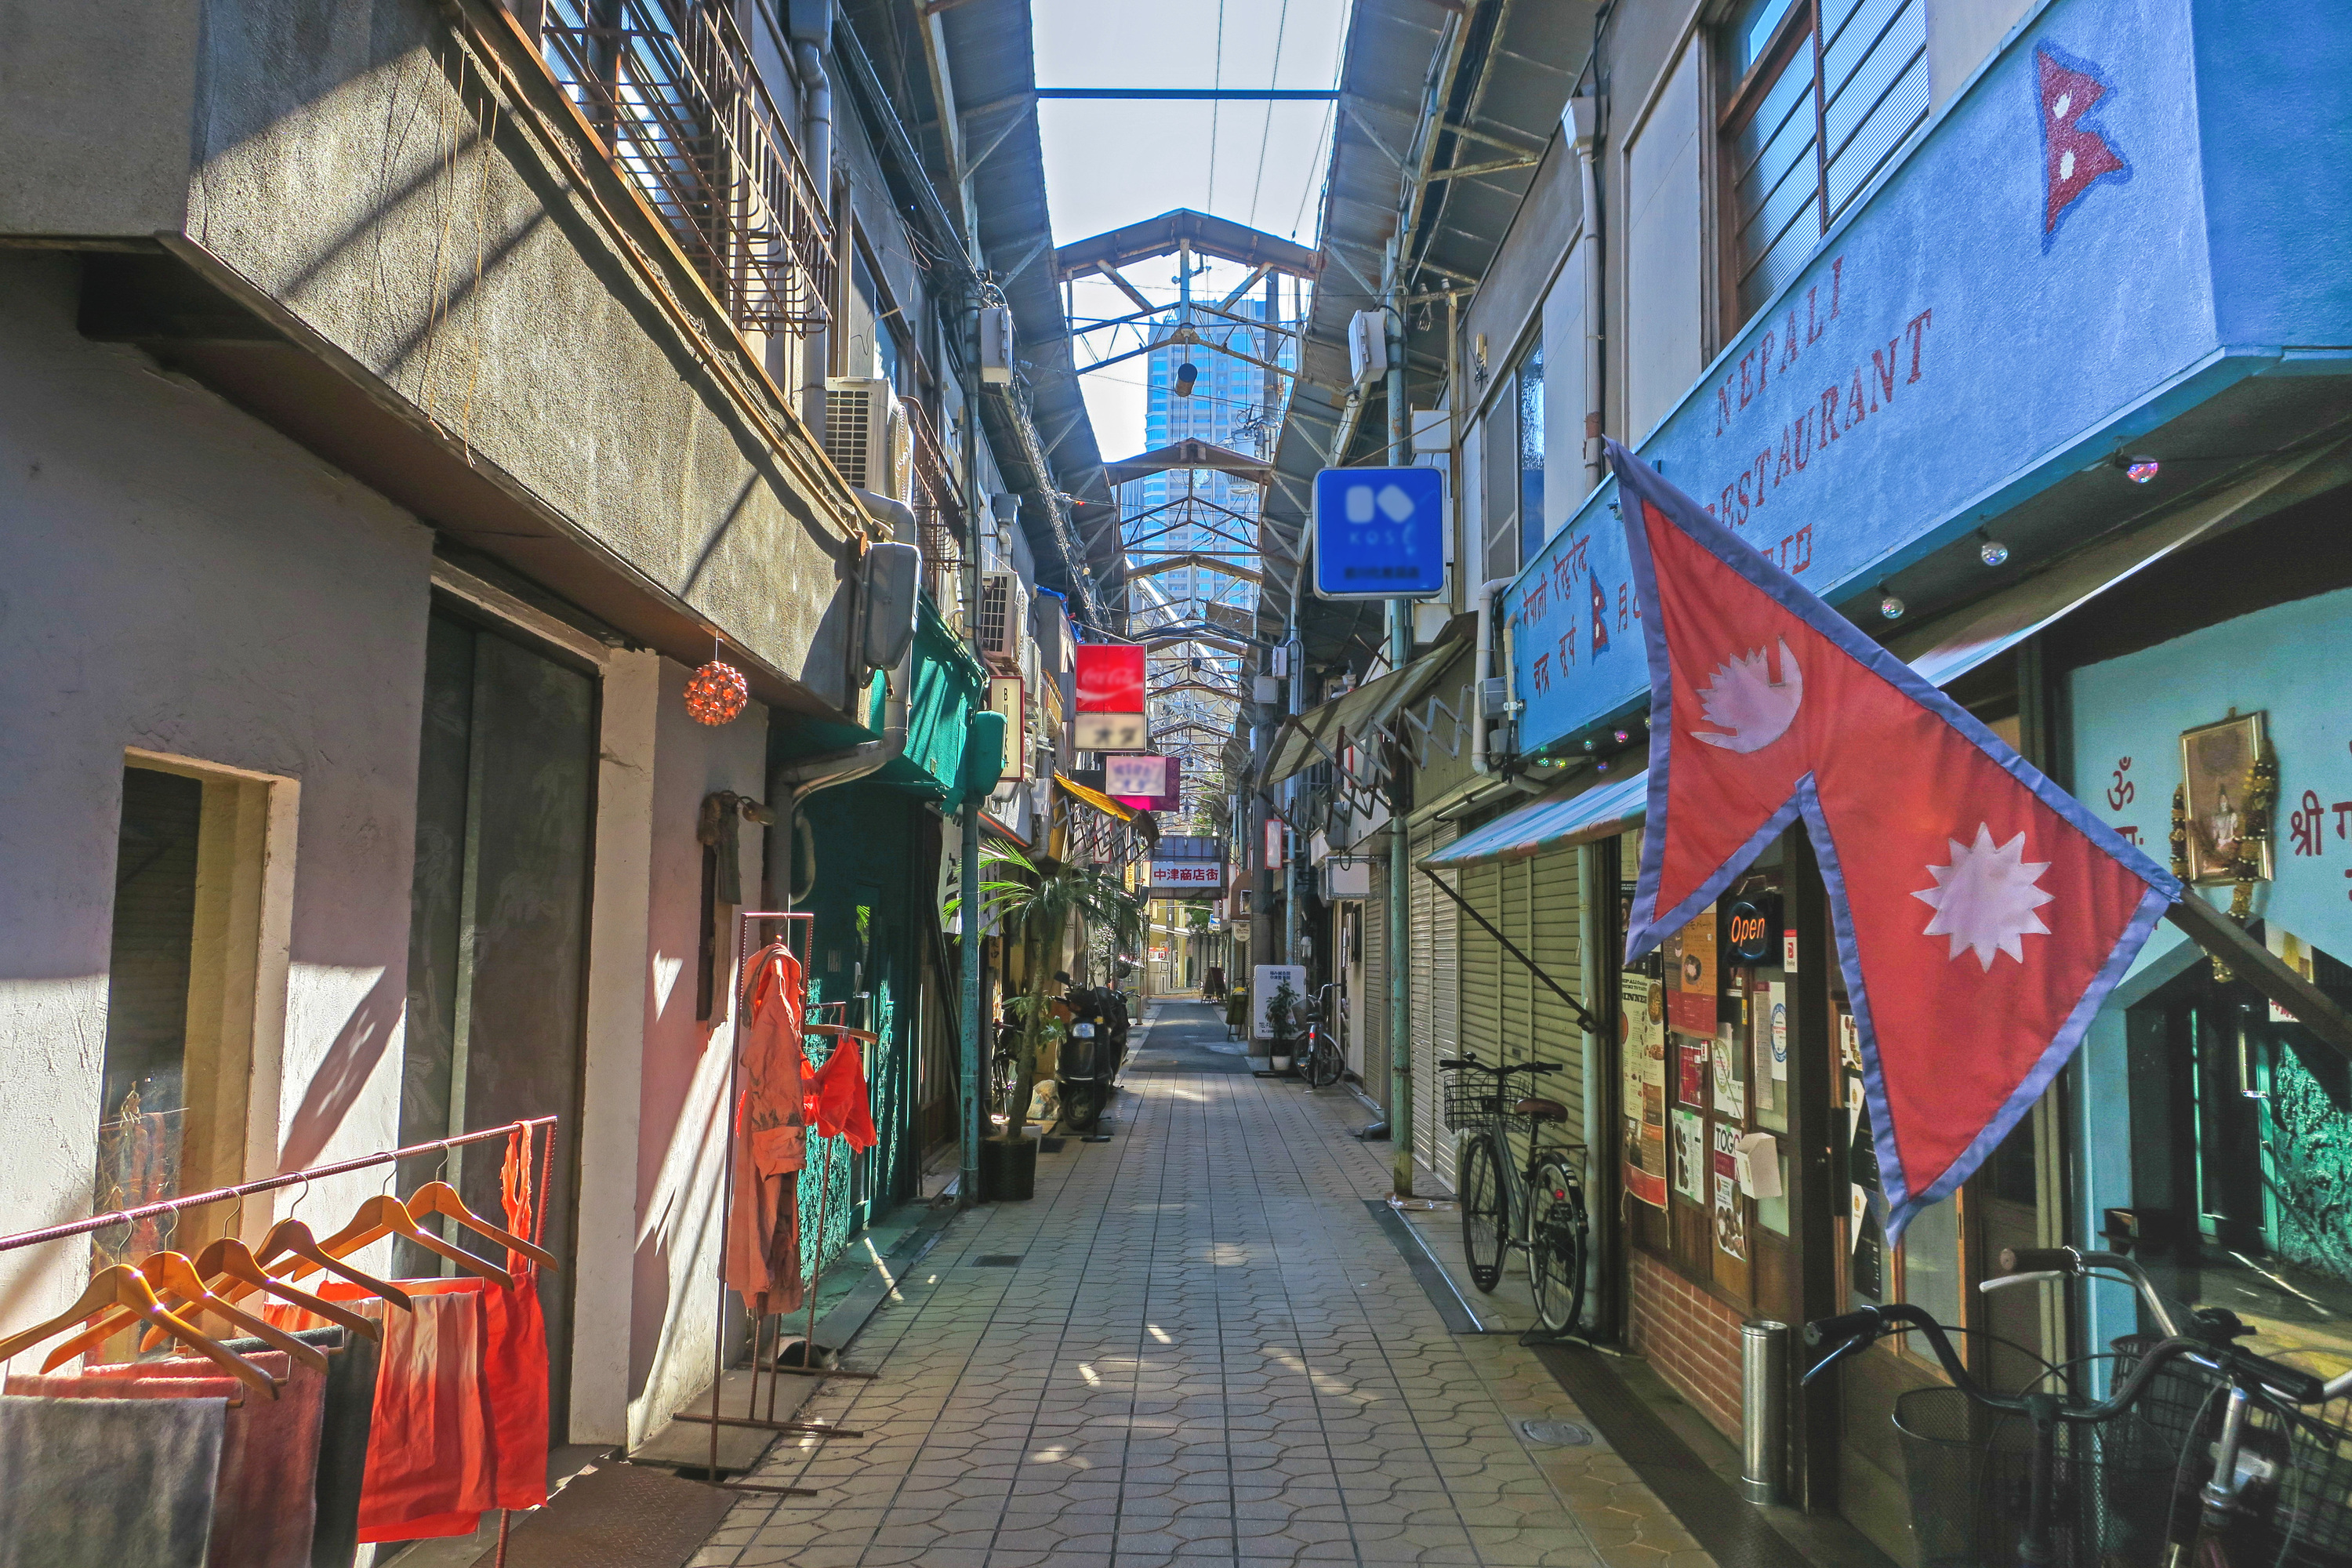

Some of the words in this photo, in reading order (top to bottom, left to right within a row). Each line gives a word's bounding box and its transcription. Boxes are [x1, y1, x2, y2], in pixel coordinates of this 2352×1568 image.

[1715, 255, 1845, 438] NEPALI
[1153, 868, 1218, 881] 中津商店街
[1731, 915, 1766, 947] Open
